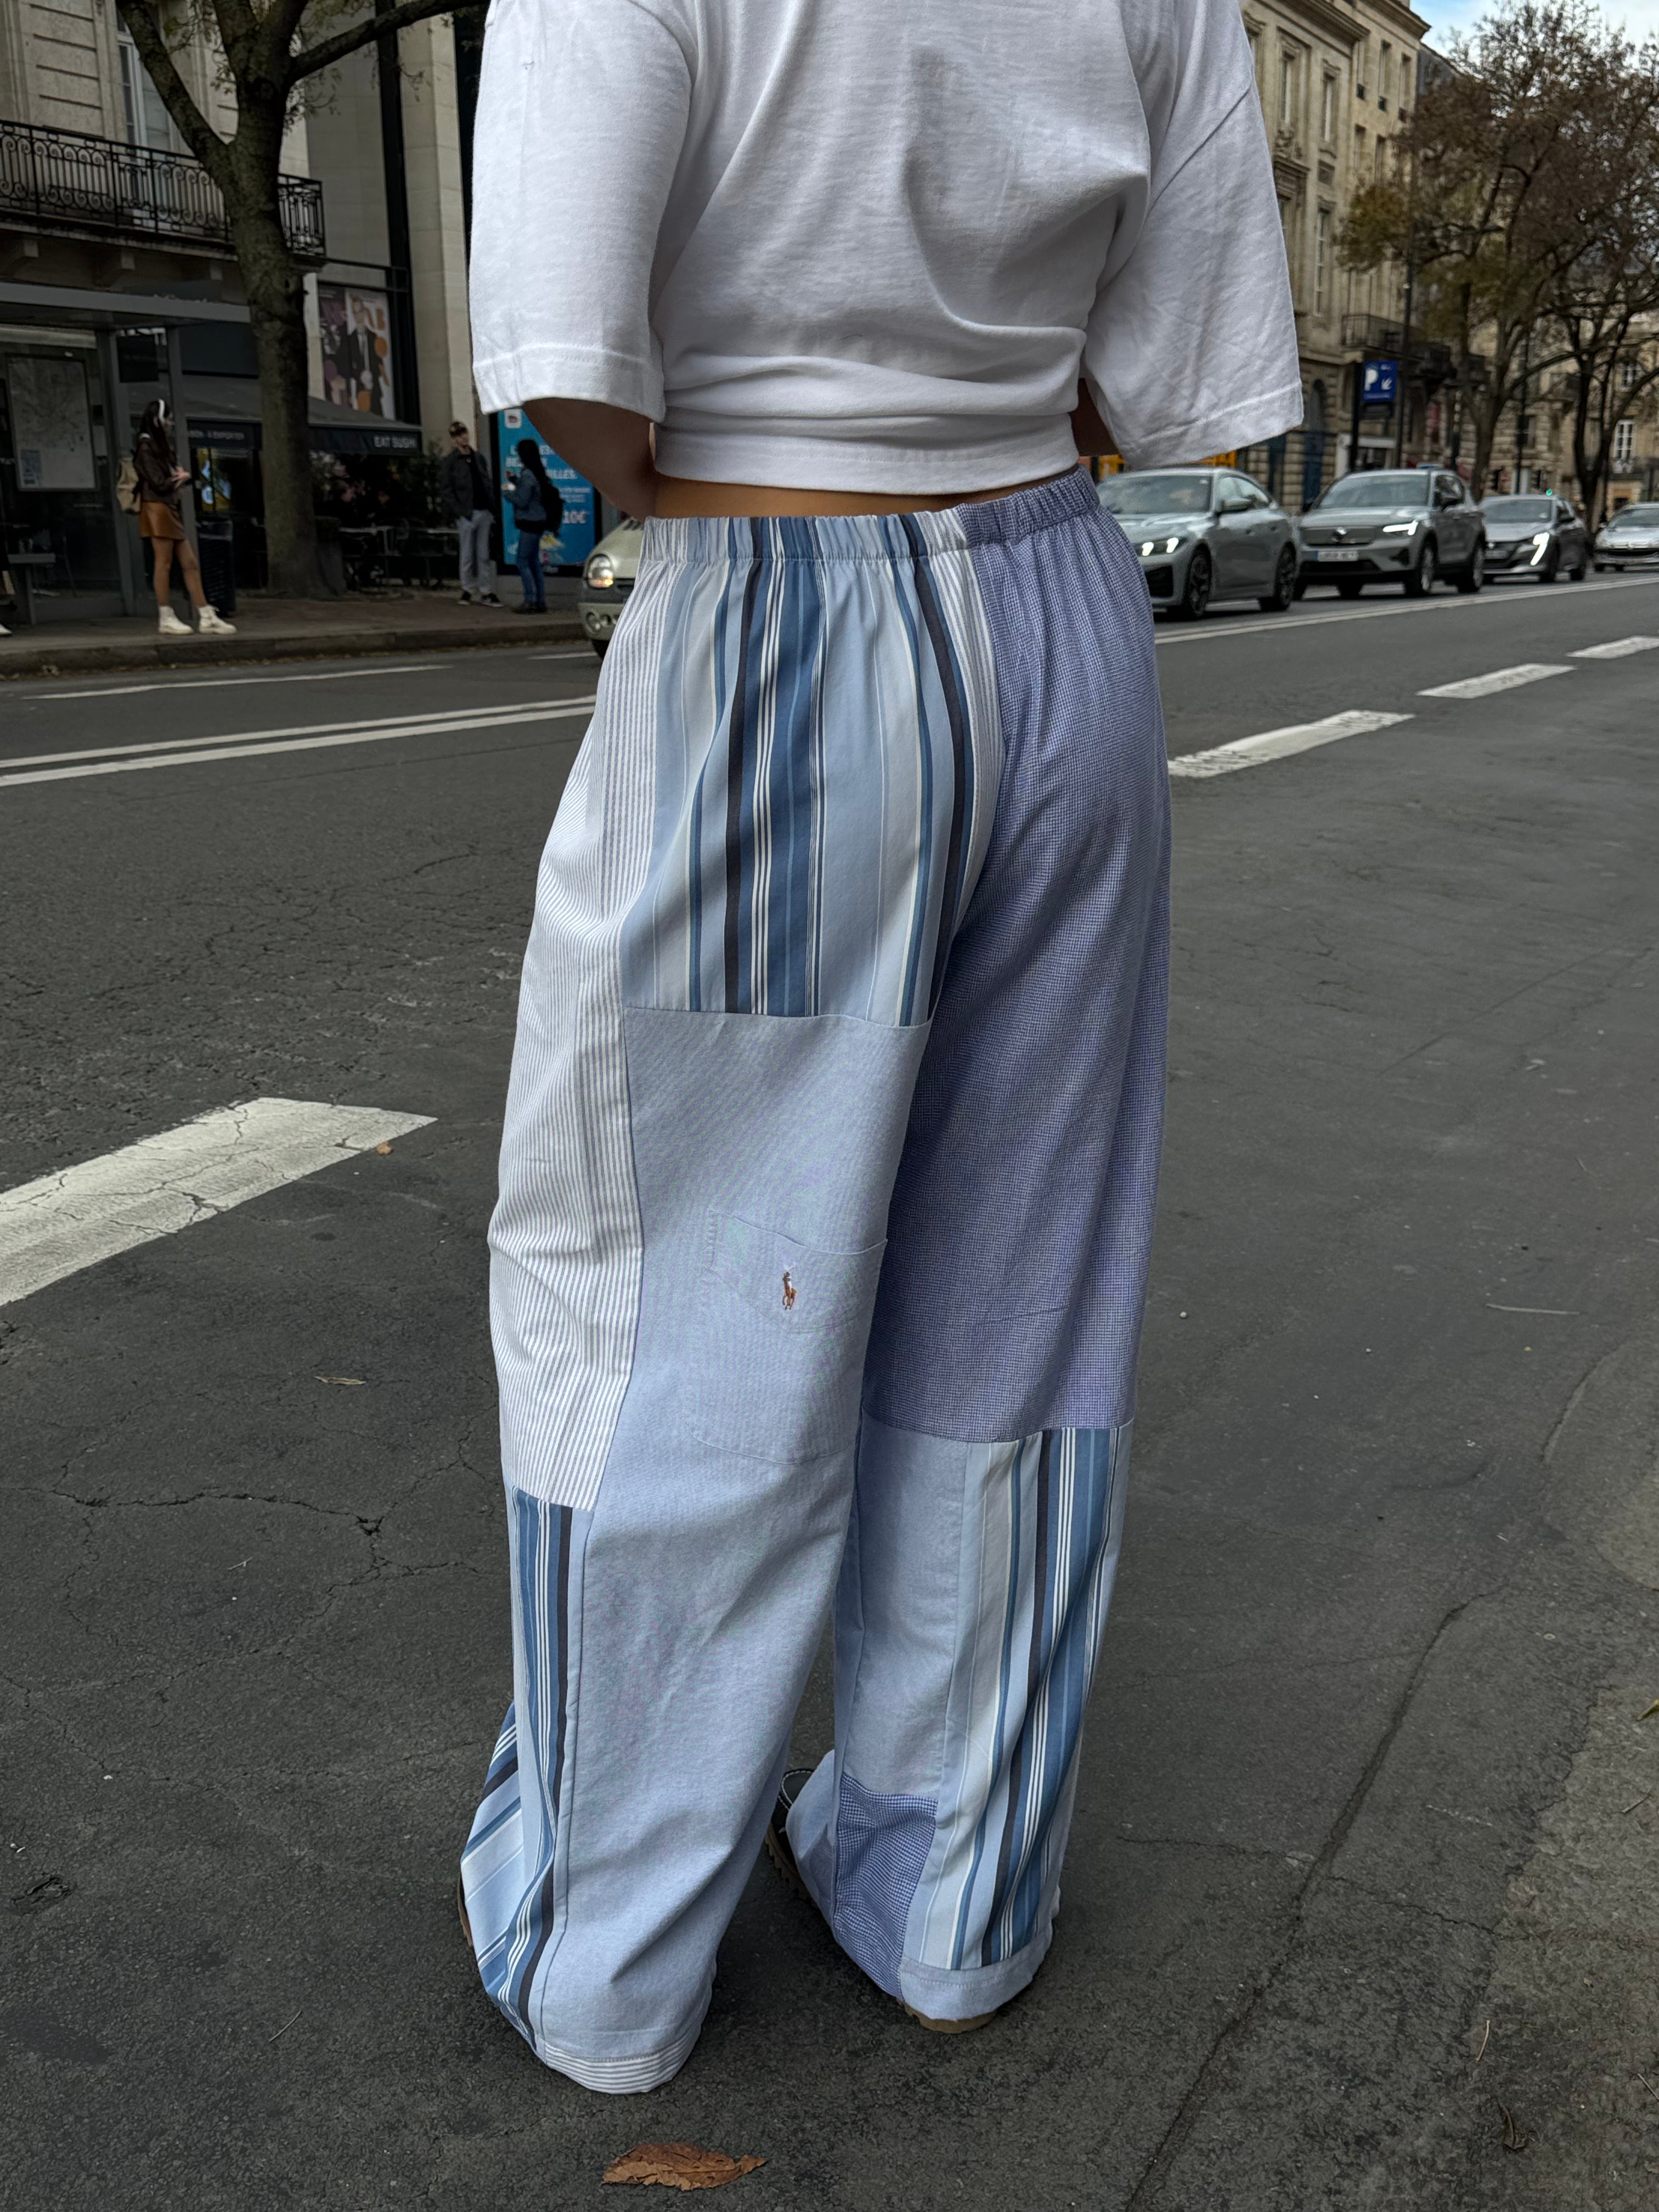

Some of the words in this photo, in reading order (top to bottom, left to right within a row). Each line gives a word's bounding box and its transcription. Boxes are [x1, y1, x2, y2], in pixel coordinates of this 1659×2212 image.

[1364, 368, 1378, 391] P
[374, 436, 390, 448] EAT
[391, 436, 416, 448] SUSHI
